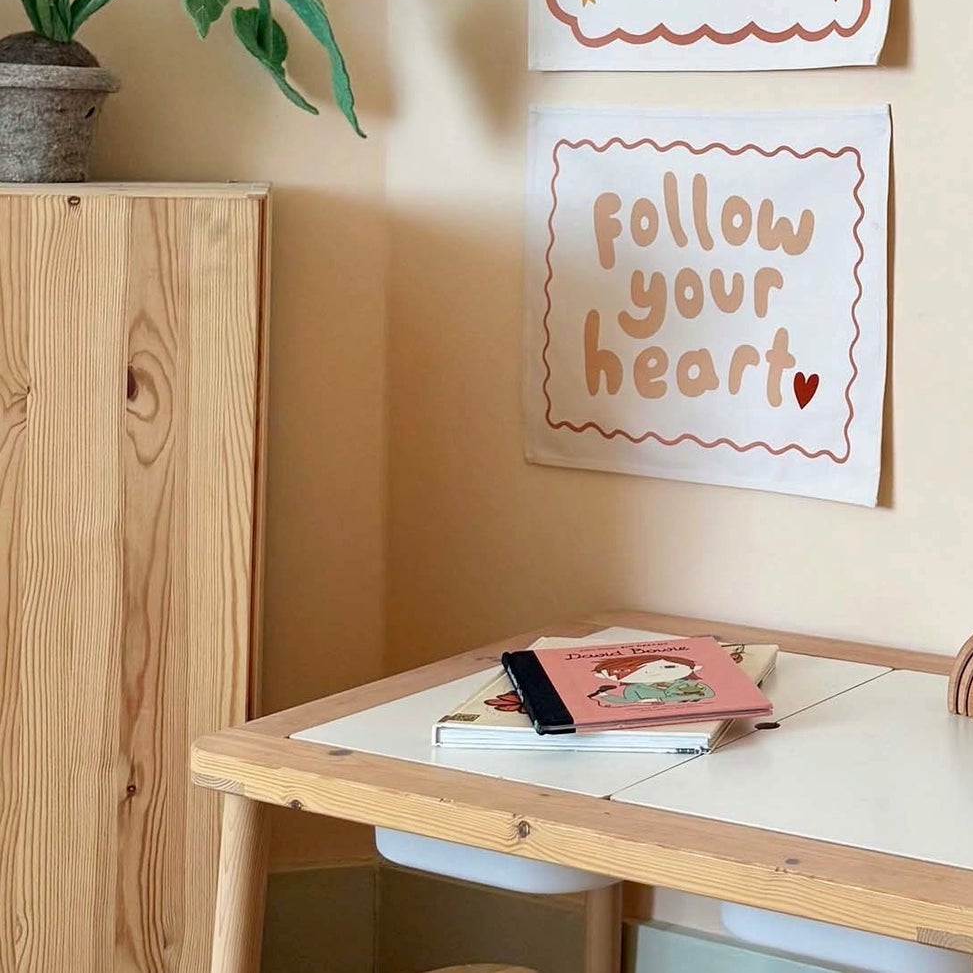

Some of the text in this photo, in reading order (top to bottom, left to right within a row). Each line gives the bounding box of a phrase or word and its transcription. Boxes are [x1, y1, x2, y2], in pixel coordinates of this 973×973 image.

[593, 171, 815, 270] follow
[618, 267, 784, 339] your
[584, 309, 797, 408] heart
